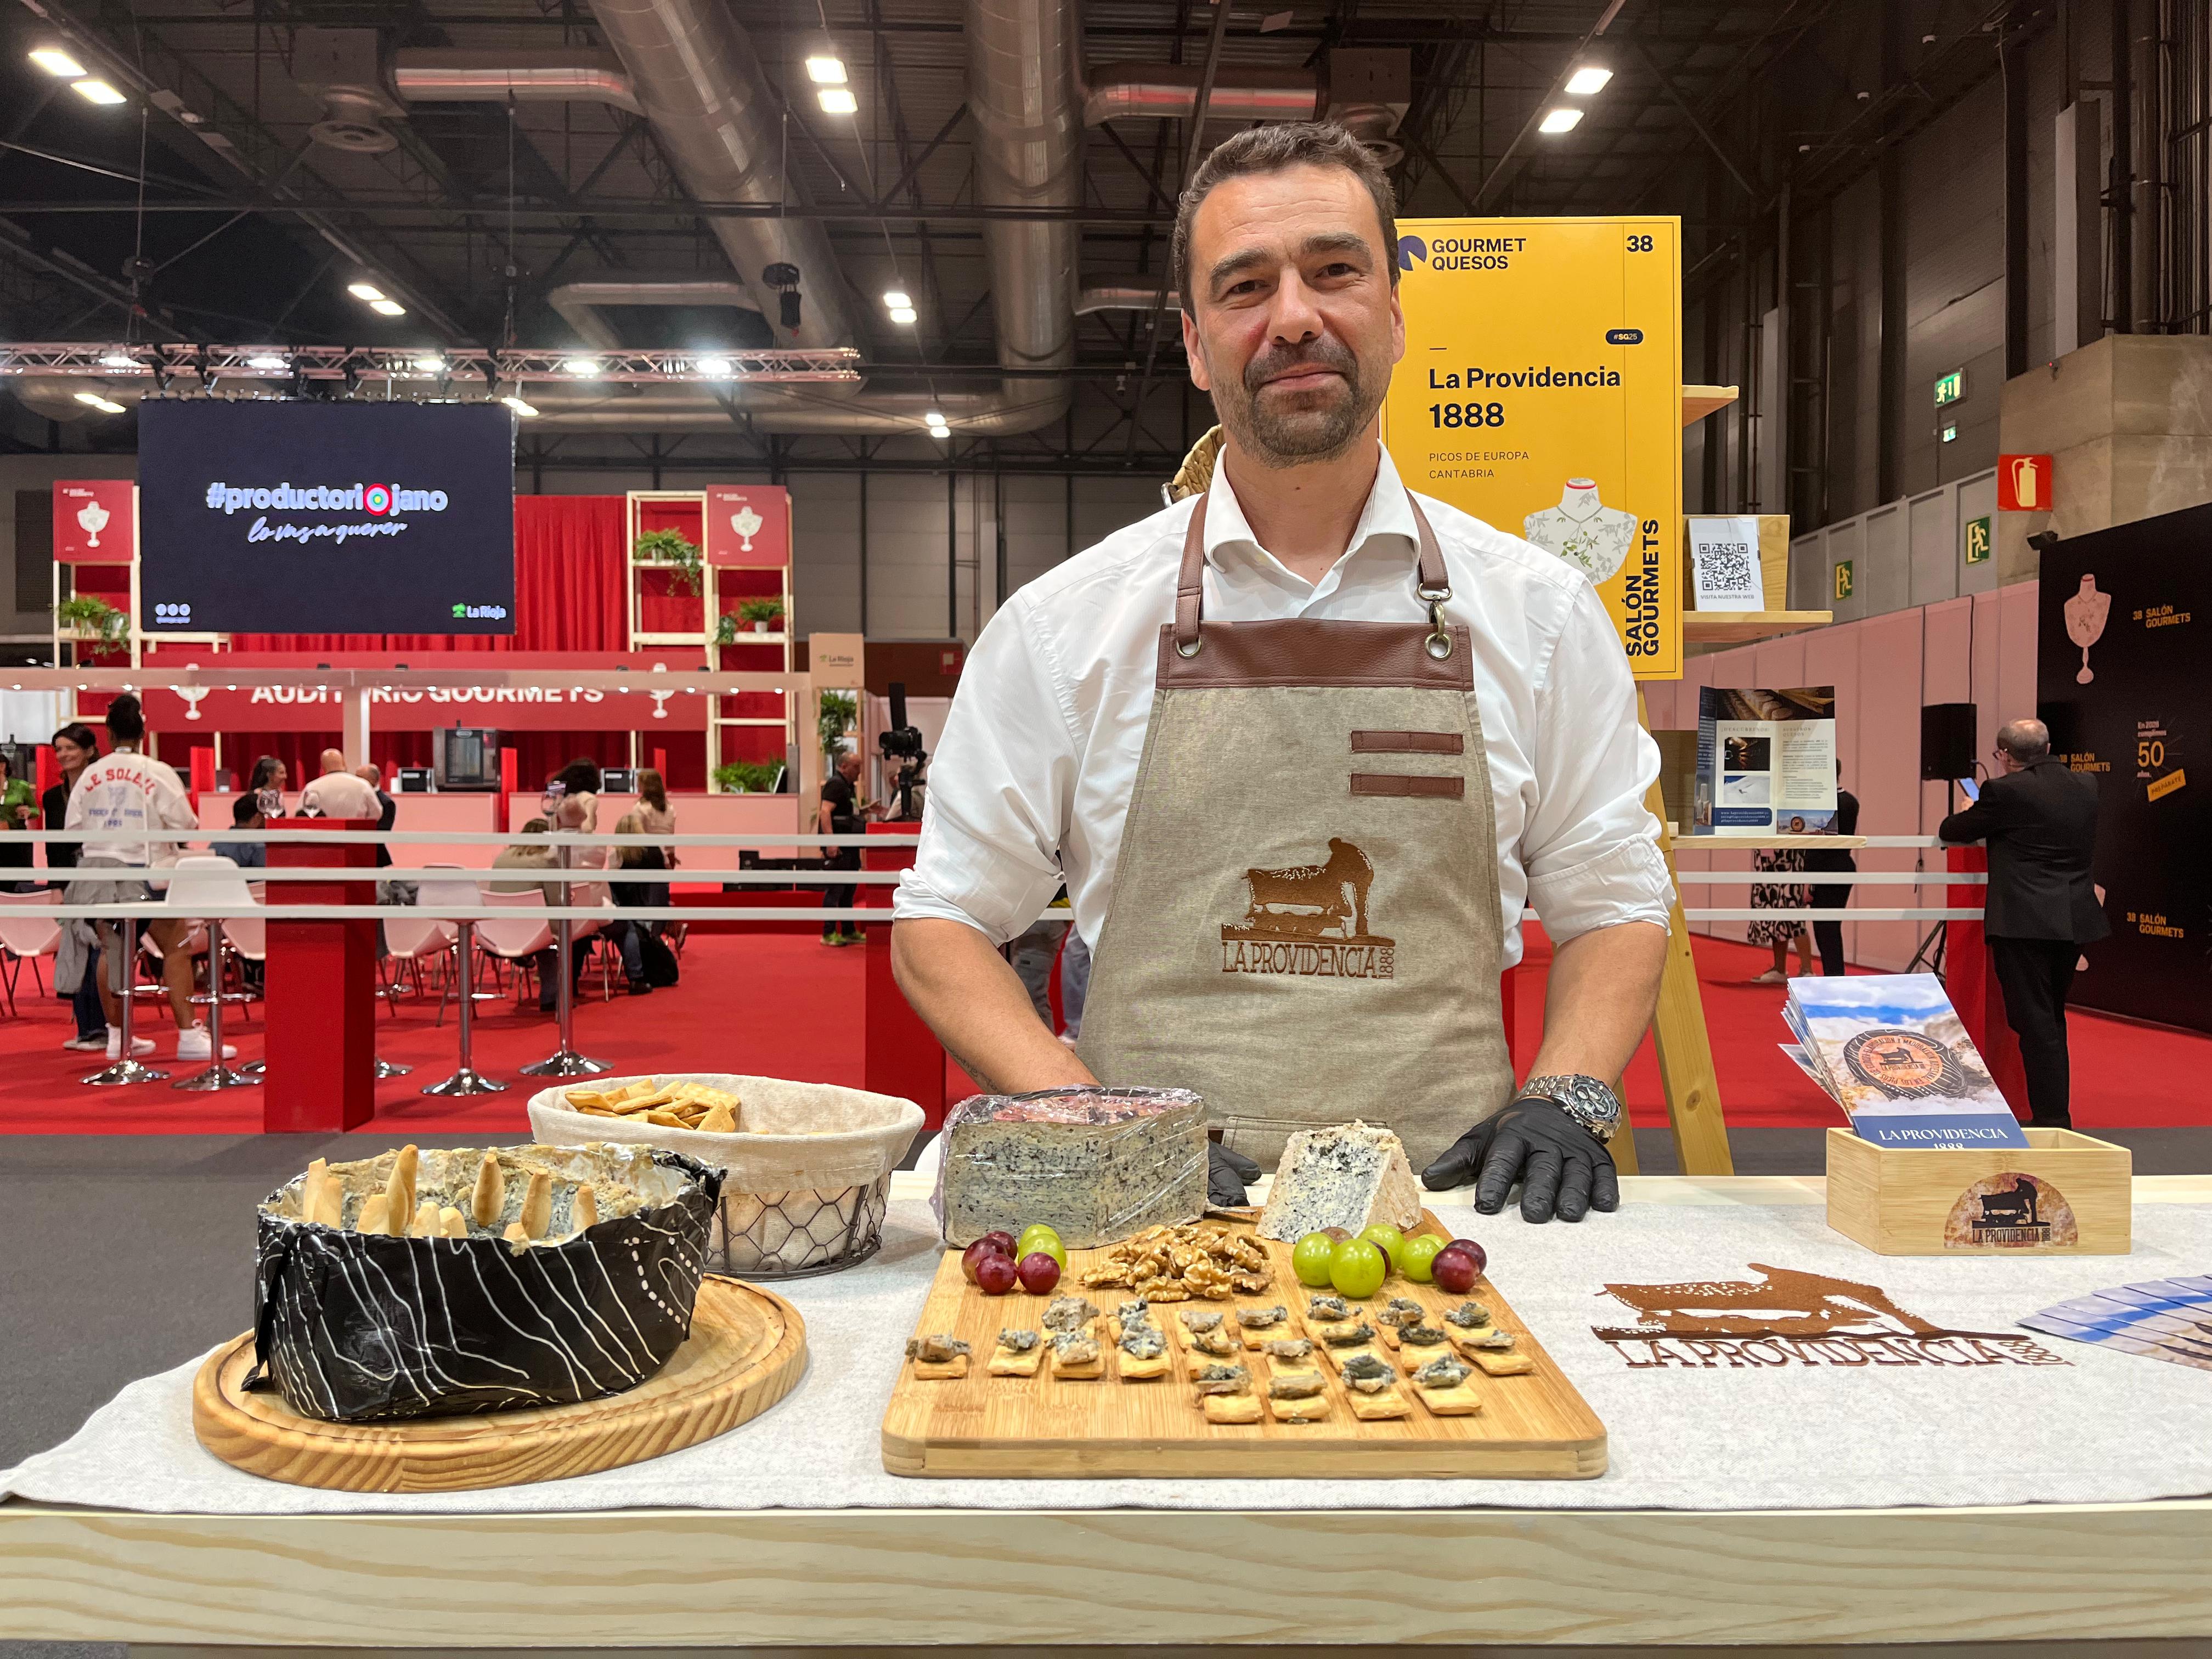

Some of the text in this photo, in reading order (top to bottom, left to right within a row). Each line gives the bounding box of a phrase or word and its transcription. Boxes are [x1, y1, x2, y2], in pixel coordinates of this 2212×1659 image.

[1431, 238, 1526, 253] GOURMET
[1626, 235, 1654, 253] 38
[1432, 256, 1509, 271] QUESOS
[1429, 366, 1621, 390] La Providencia
[1429, 402, 1505, 428] 1888
[1429, 451, 1530, 462] PICOS DE EUROPA
[1429, 469, 1494, 479] CANTABRIA
[1643, 519, 1660, 657] GOURMETS
[1621, 575, 1642, 657] SALÓN
[2146, 604, 2173, 618] SALÓN
[2146, 612, 2191, 628] GOURMETS
[2138, 741, 2164, 768] 50
[2070, 761, 2111, 772] GOURMETS
[2140, 913, 2166, 926] SALÓN
[2139, 924, 2184, 938] GOURMETS
[1222, 941, 1395, 979] LA PROVIDENCIA 1888
[1879, 1128, 2009, 1140] LA PROVIDENCIA
[1972, 1228, 1984, 1243] LA
[1985, 1228, 2040, 1243] PROVIDENCIA
[1605, 1339, 2076, 1368] LA PROVIDENCIA 1888
